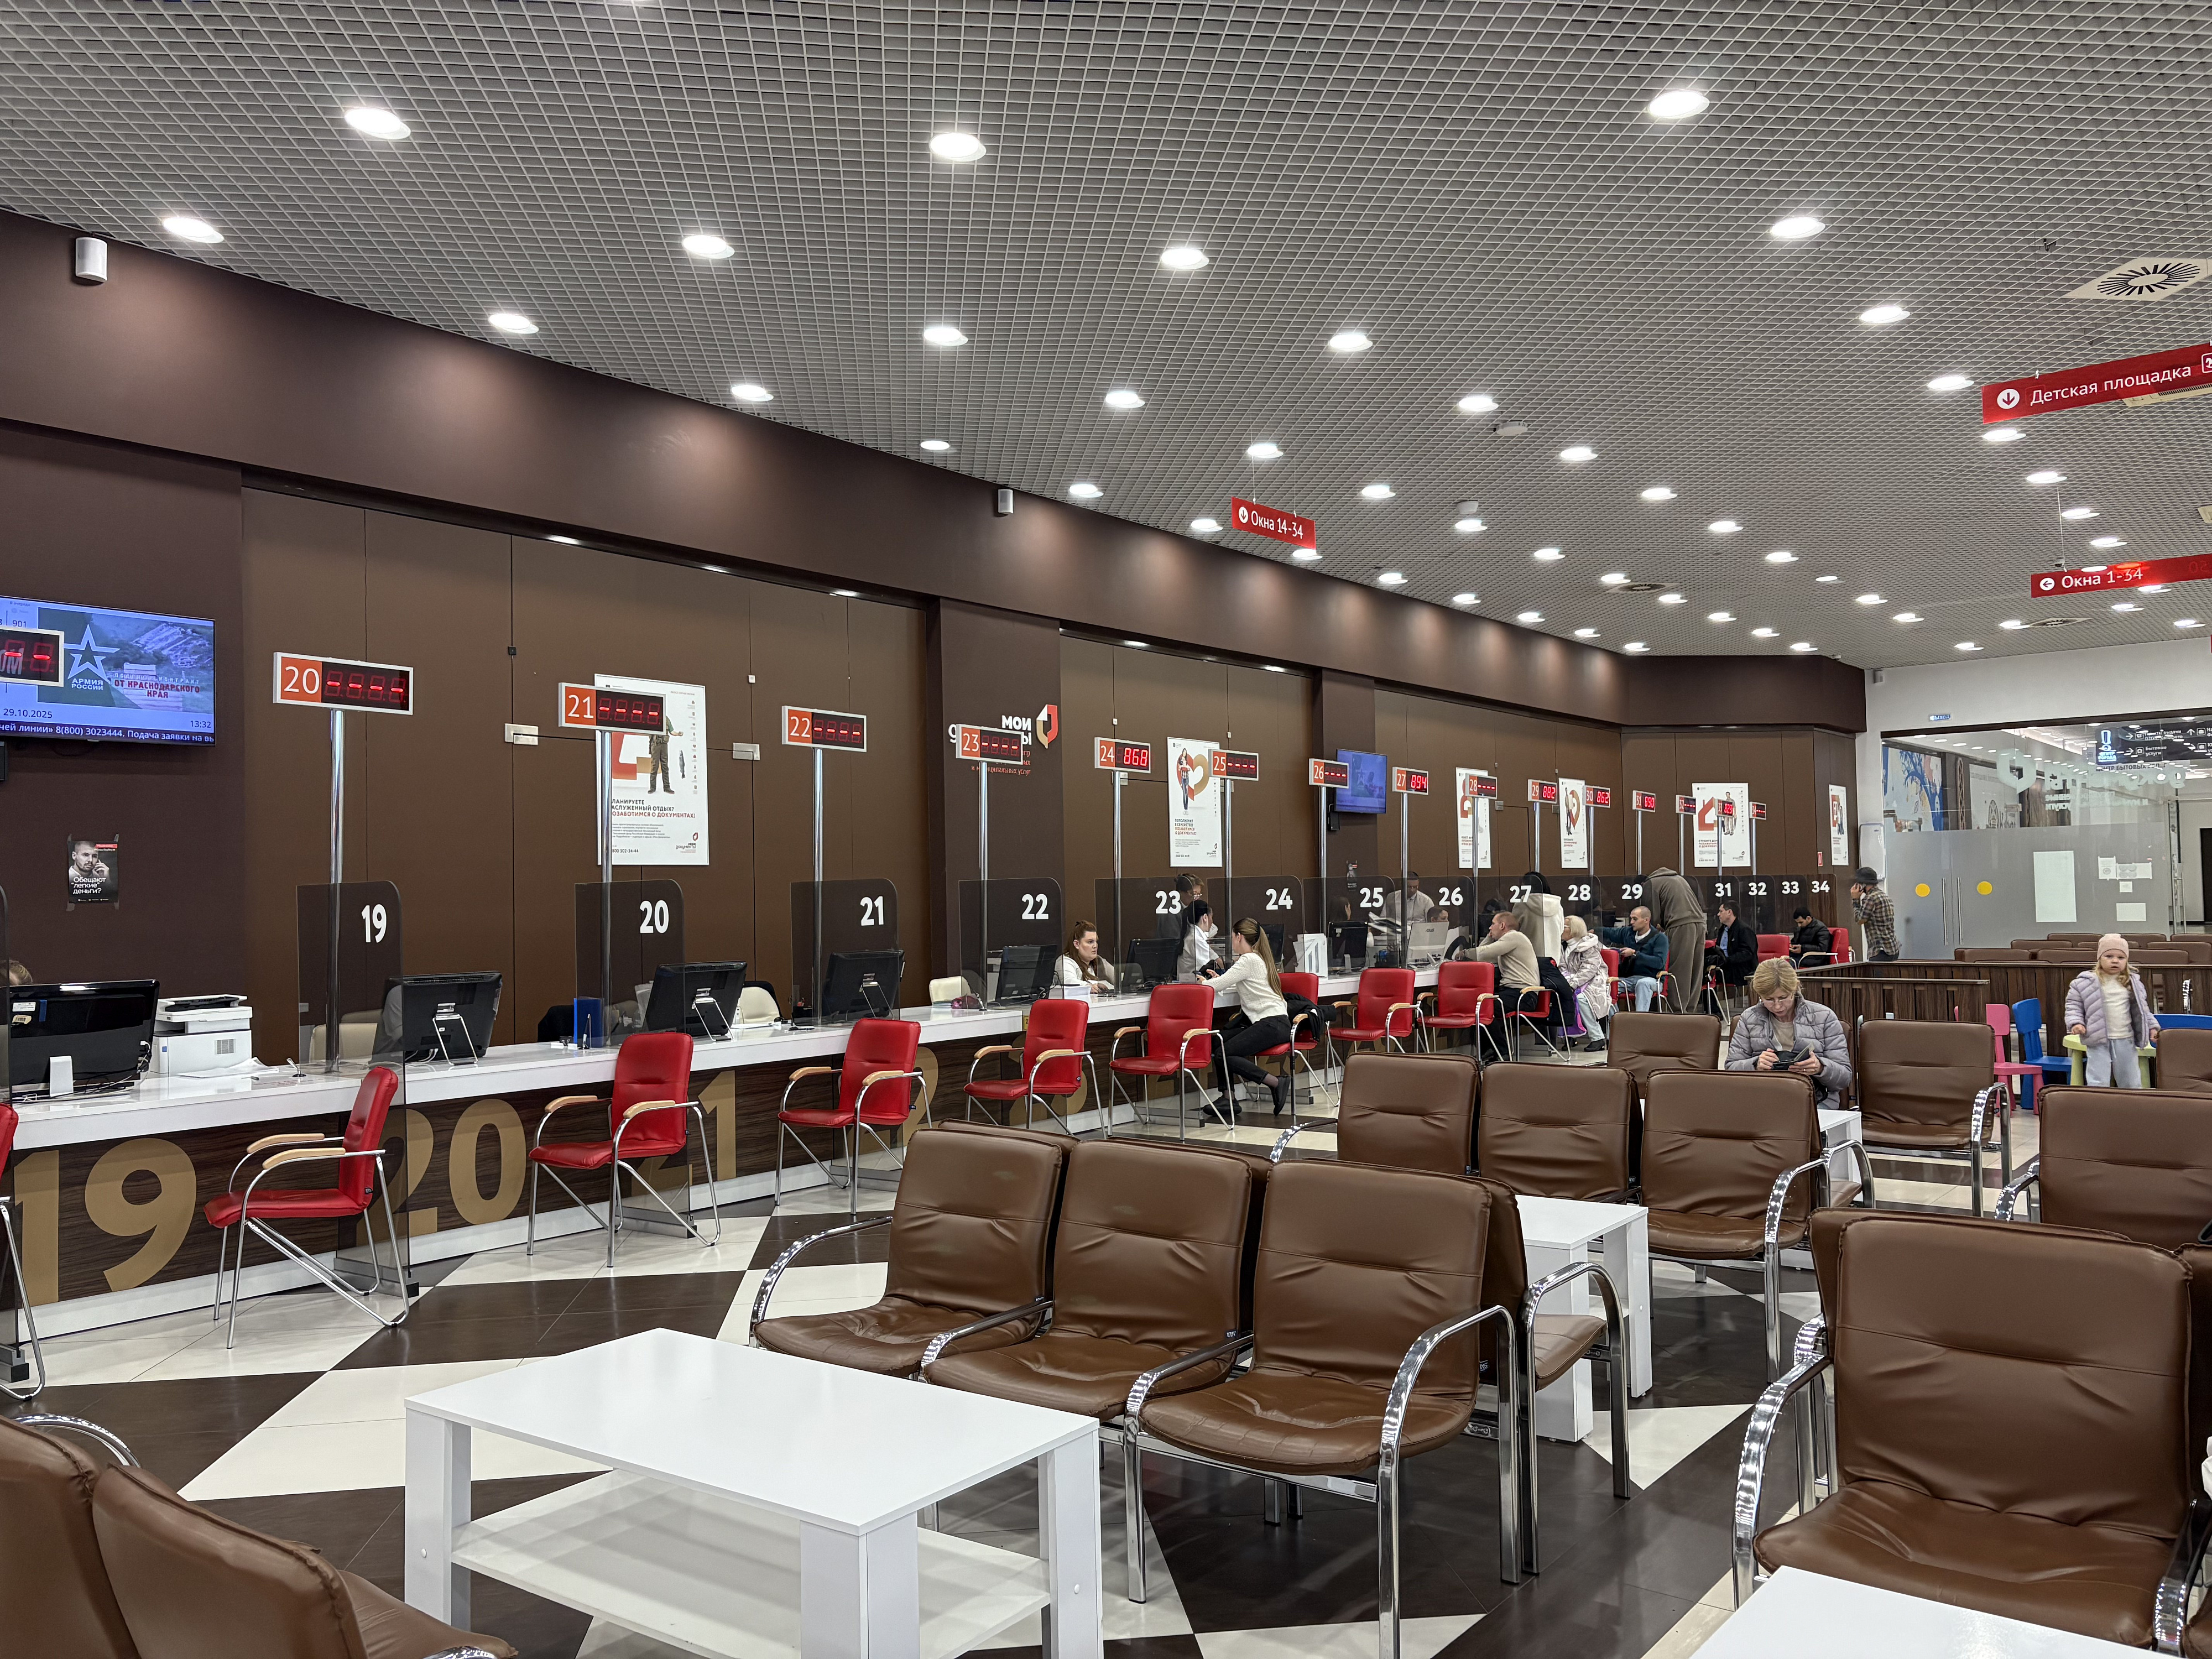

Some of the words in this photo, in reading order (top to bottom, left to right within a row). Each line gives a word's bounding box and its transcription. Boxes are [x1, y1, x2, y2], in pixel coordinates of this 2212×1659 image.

[2030, 382, 2098, 406] Детская
[2104, 366, 2192, 391] площадка
[1251, 510, 1275, 530] Окна
[1277, 518, 1303, 540] 14-34
[2062, 575, 2101, 588] Окна
[2106, 568, 2143, 583] 1-34
[12, 620, 27, 628] 901
[128, 681, 200, 693] КРАСНОДАРСКОГО
[283, 665, 320, 695] 20
[3, 708, 53, 718] 29.10.2025
[568, 695, 594, 719] 21
[190, 720, 211, 728] 13:32
[790, 716, 811, 738] 22
[1001, 715, 1031, 731] мои
[18, 725, 53, 733] линии»
[56, 726, 84, 736] 8(800)
[85, 728, 125, 737] 3023444.
[127, 730, 159, 740] Подача
[161, 733, 190, 741] заявки
[963, 733, 979, 752] 23
[1100, 745, 1115, 763] 24
[1123, 748, 1149, 767] 868
[1214, 755, 1227, 771] 25
[1314, 765, 1324, 780] 26
[1397, 773, 1406, 787] 27
[1411, 775, 1427, 789] 894
[1469, 779, 1478, 792] 28
[1531, 784, 1539, 796] 29
[1542, 785, 1556, 799] 882
[1586, 790, 1593, 801] 30
[1597, 791, 1609, 804] 862
[1636, 795, 1642, 806] 31
[1510, 885, 1532, 903] 27
[1568, 884, 1591, 901] 28
[1621, 884, 1643, 900] 29
[1715, 883, 1731, 897] 31
[1748, 882, 1767, 896] 32
[1782, 881, 1799, 894] 33
[1812, 880, 1830, 893] 34
[1155, 890, 1181, 914] 23
[1266, 888, 1293, 910] 24
[1360, 887, 1384, 907] 25
[1439, 886, 1463, 906] 26
[860, 896, 884, 926] 21
[1021, 894, 1049, 920] 22
[362, 904, 387, 943] 19
[639, 900, 669, 933] 20
[14, 1138, 197, 1307] 19
